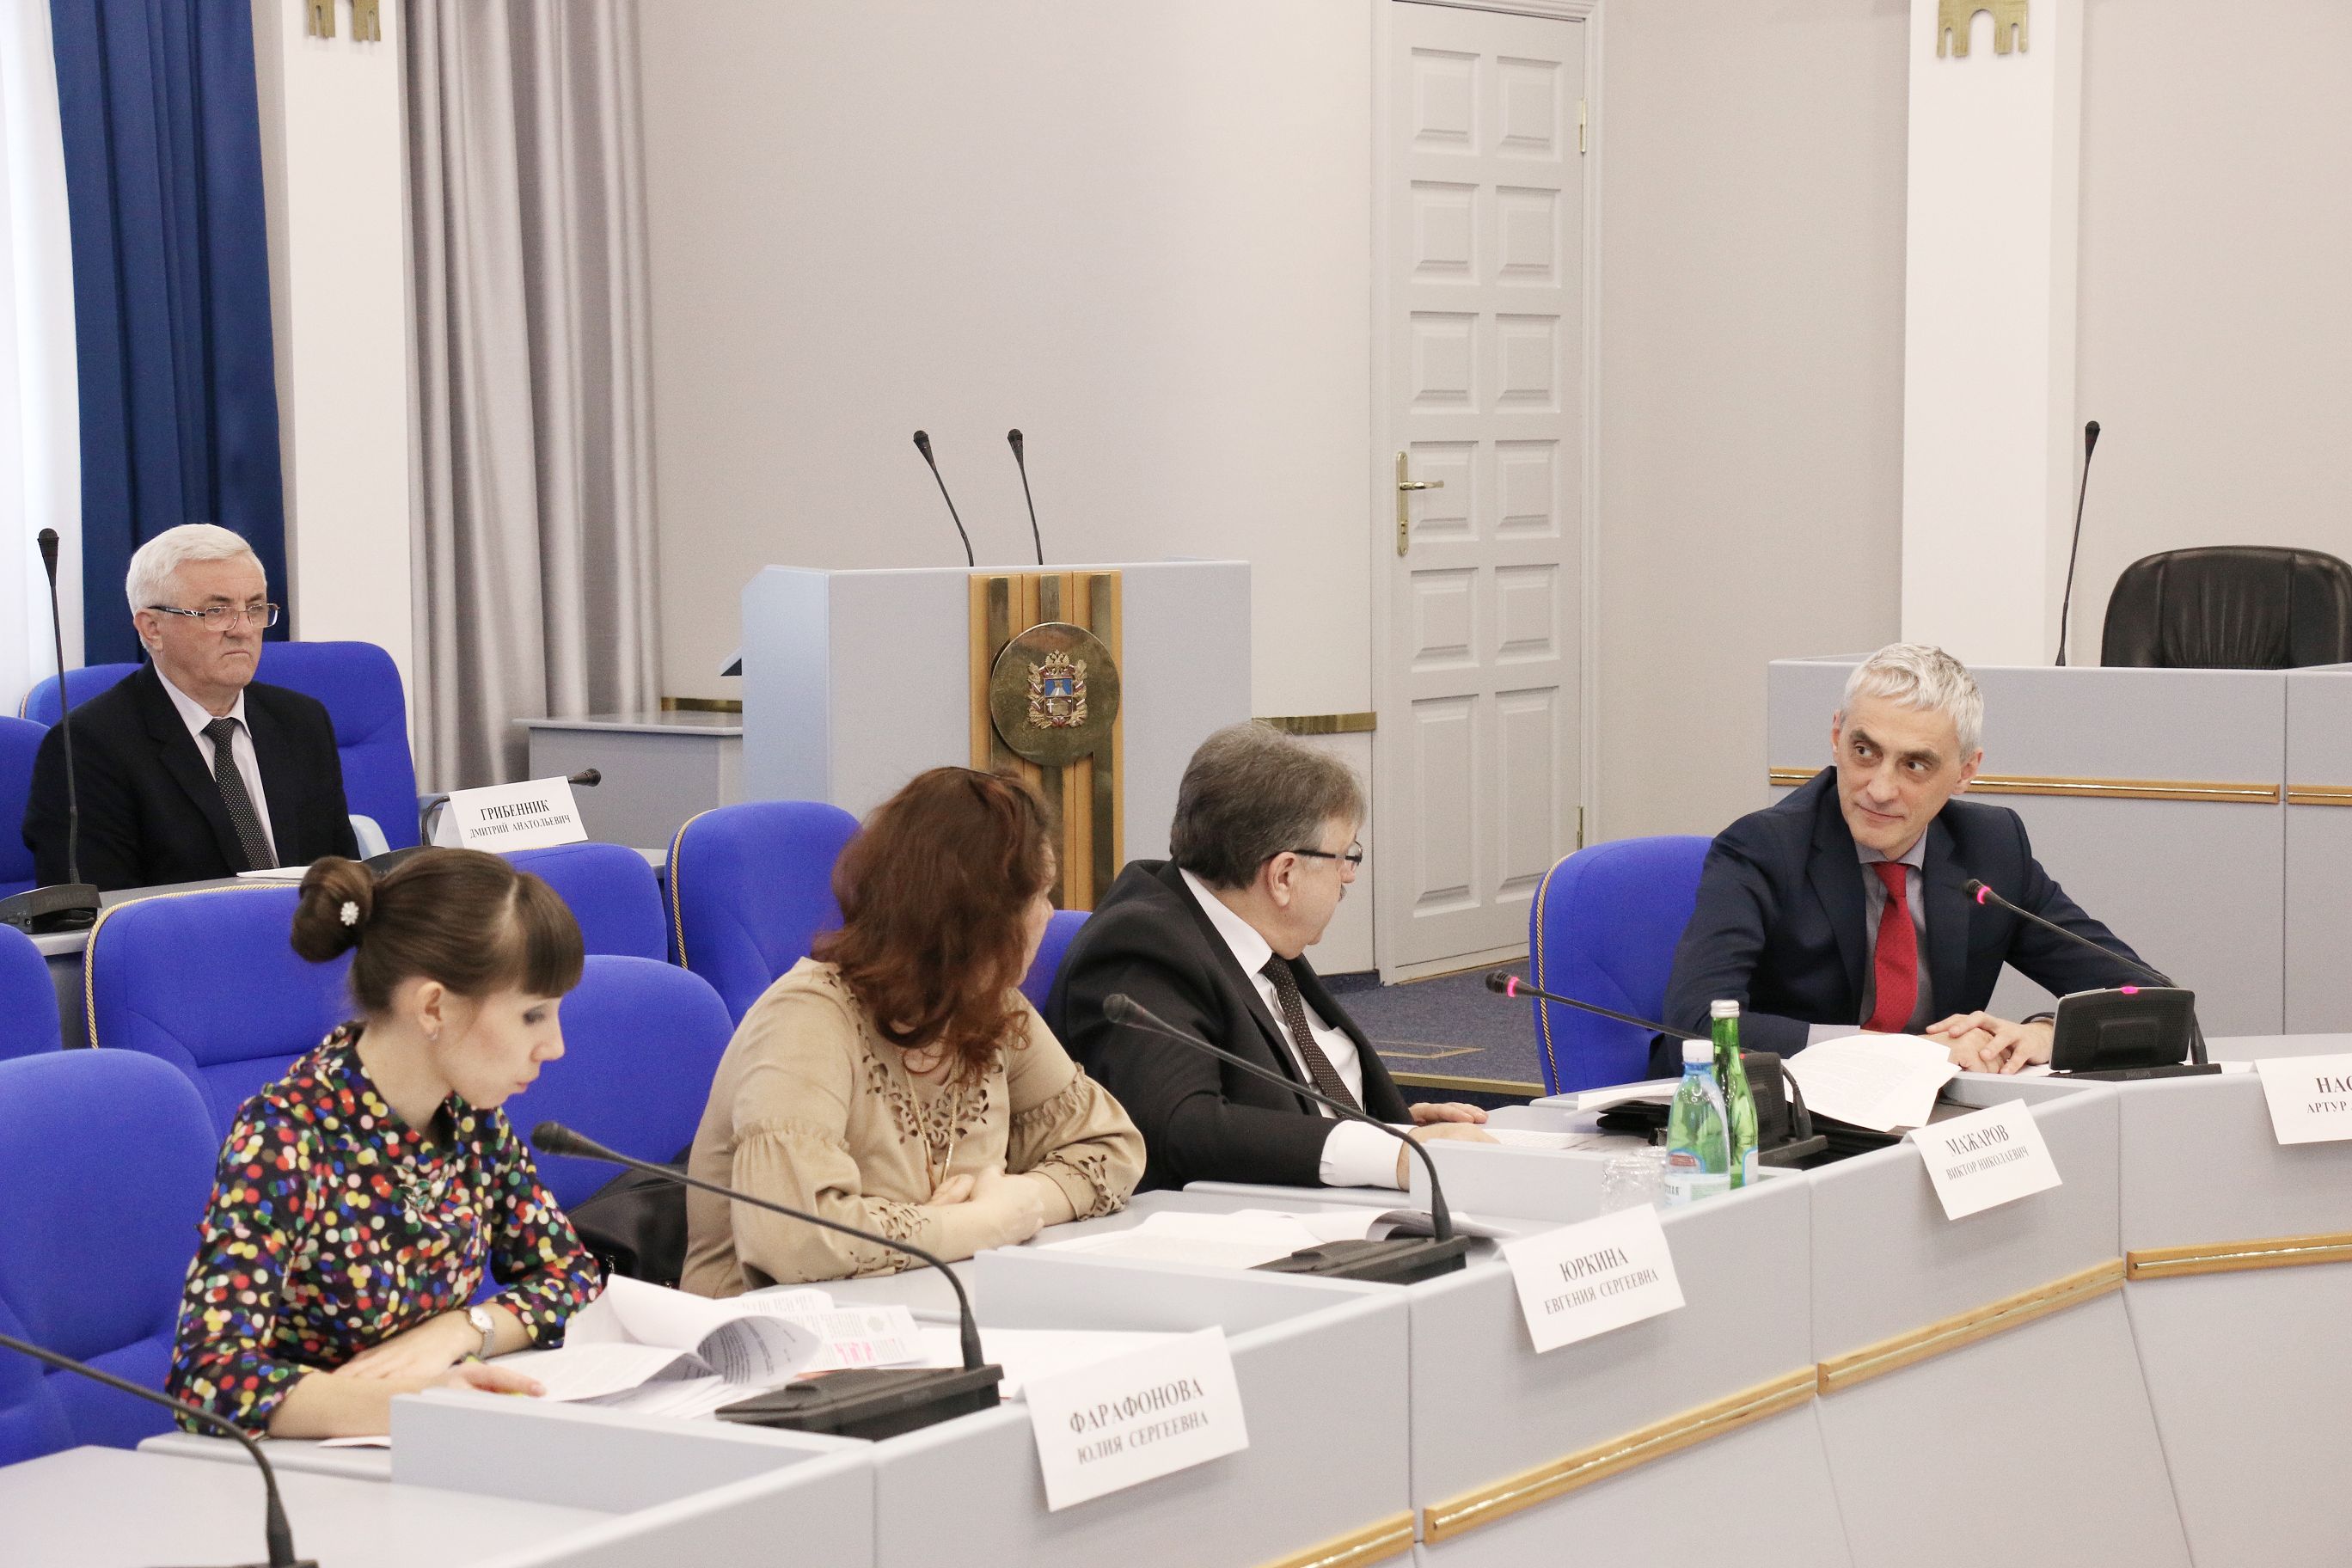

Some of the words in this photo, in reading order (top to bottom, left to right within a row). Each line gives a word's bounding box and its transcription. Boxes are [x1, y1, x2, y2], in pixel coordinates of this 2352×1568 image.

[469, 823, 510, 839] ДМИТРИЙ
[512, 814, 571, 831] АНАТОЛЬЕВИЧ
[480, 799, 550, 821] ГРИБЕННИК
[2306, 1100, 2347, 1114] АРТУР
[1945, 1124, 2009, 1157] МАЖАРОВ
[1945, 1161, 1978, 1181] ВИКТОР
[1977, 1145, 2030, 1171] НИКОЛАЕВИЧ
[1559, 1246, 1629, 1283] ЮРКИНА
[1544, 1287, 1596, 1314] ЕВГЕНИЯ
[1599, 1268, 1659, 1297] СЕРГЕЕВНА
[1070, 1378, 1204, 1434] ФАРАФОНОВА
[1077, 1436, 1123, 1465] ЮЛИЯ
[1129, 1410, 1210, 1448] СЕРГЕЕВНА
